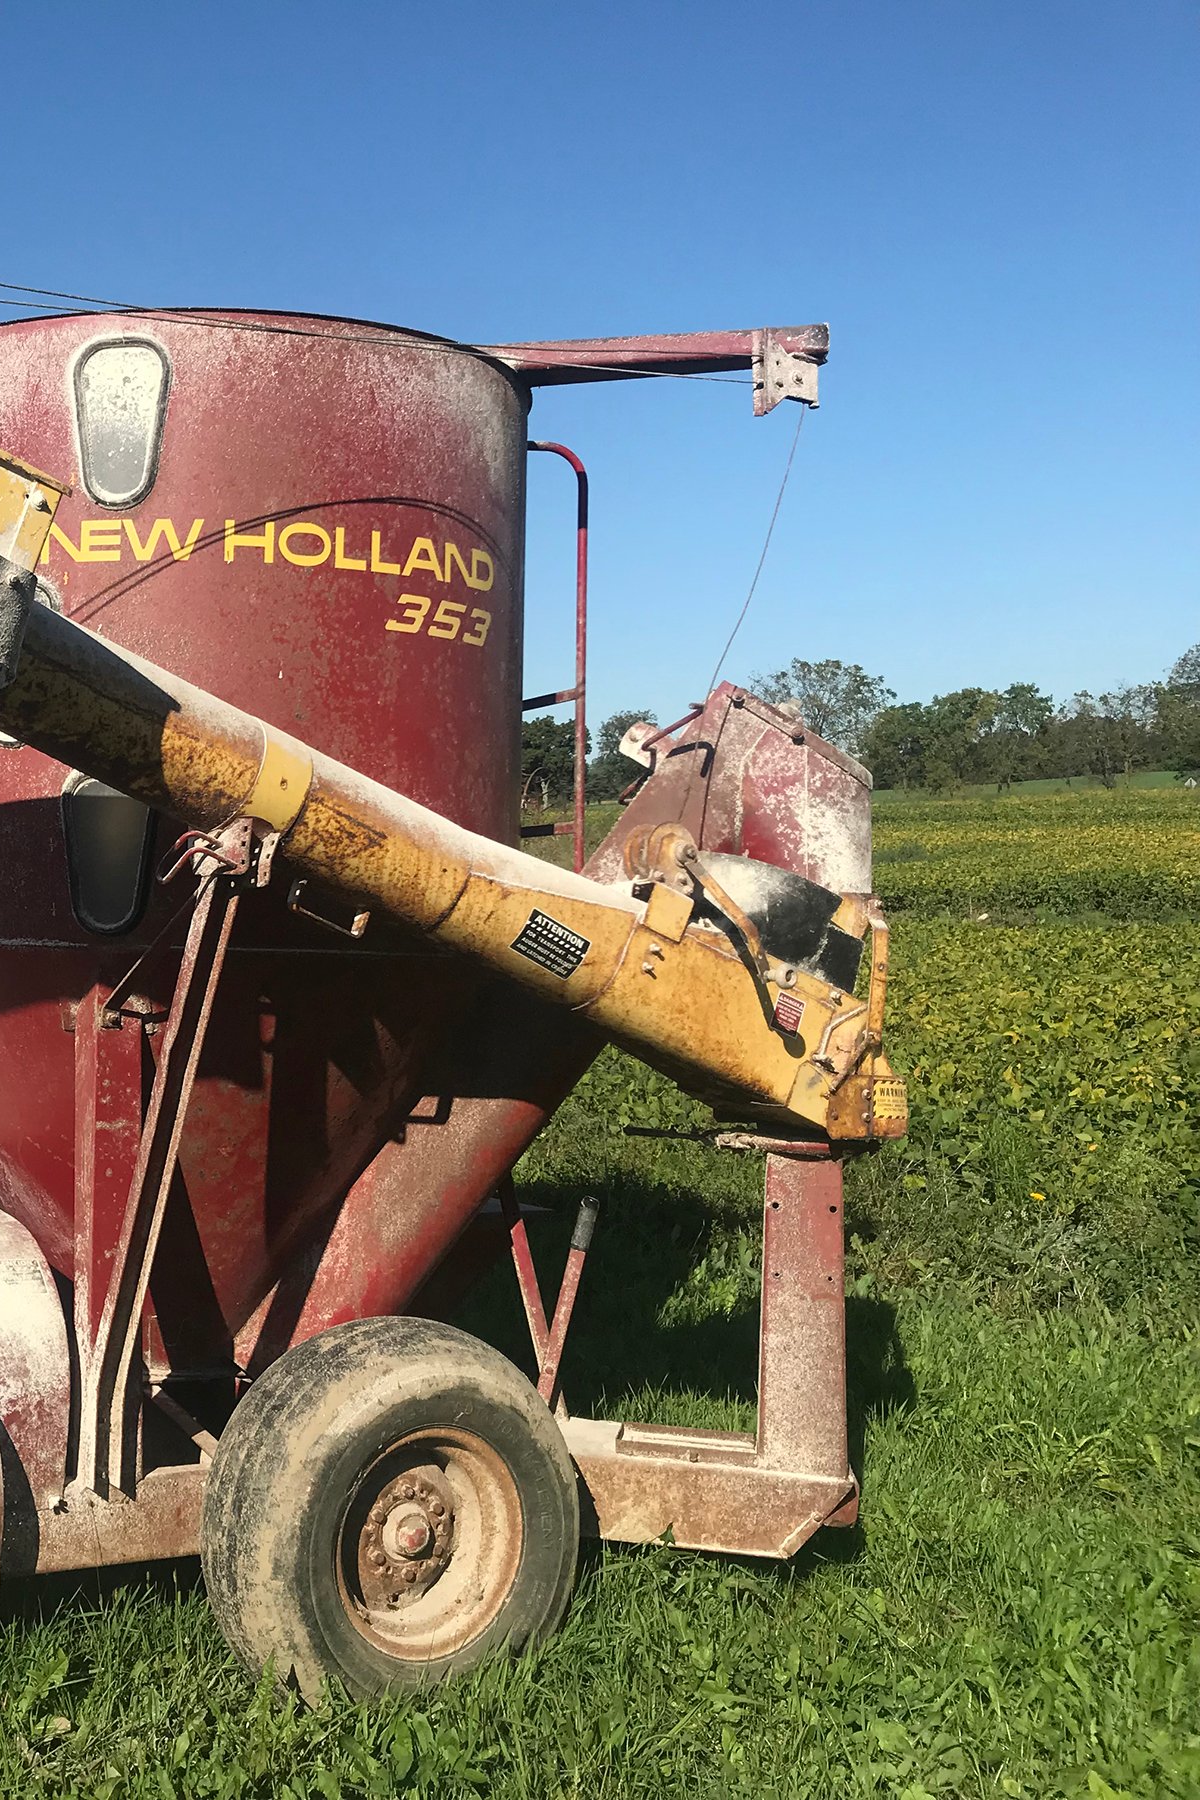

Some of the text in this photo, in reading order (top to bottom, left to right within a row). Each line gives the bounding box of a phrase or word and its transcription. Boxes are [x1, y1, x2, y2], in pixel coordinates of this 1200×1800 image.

[40, 518, 494, 592] NEW HOLLAND
[385, 593, 492, 647] 353
[526, 930, 577, 963] FOR TRANSPORT THIS
[534, 915, 585, 949] ATTENTION
[516, 942, 527, 951] AND
[526, 948, 545, 962] LATCHED
[521, 936, 537, 948] AUGER
[536, 945, 549, 956] MUST
[554, 956, 572, 969] FOLDED
